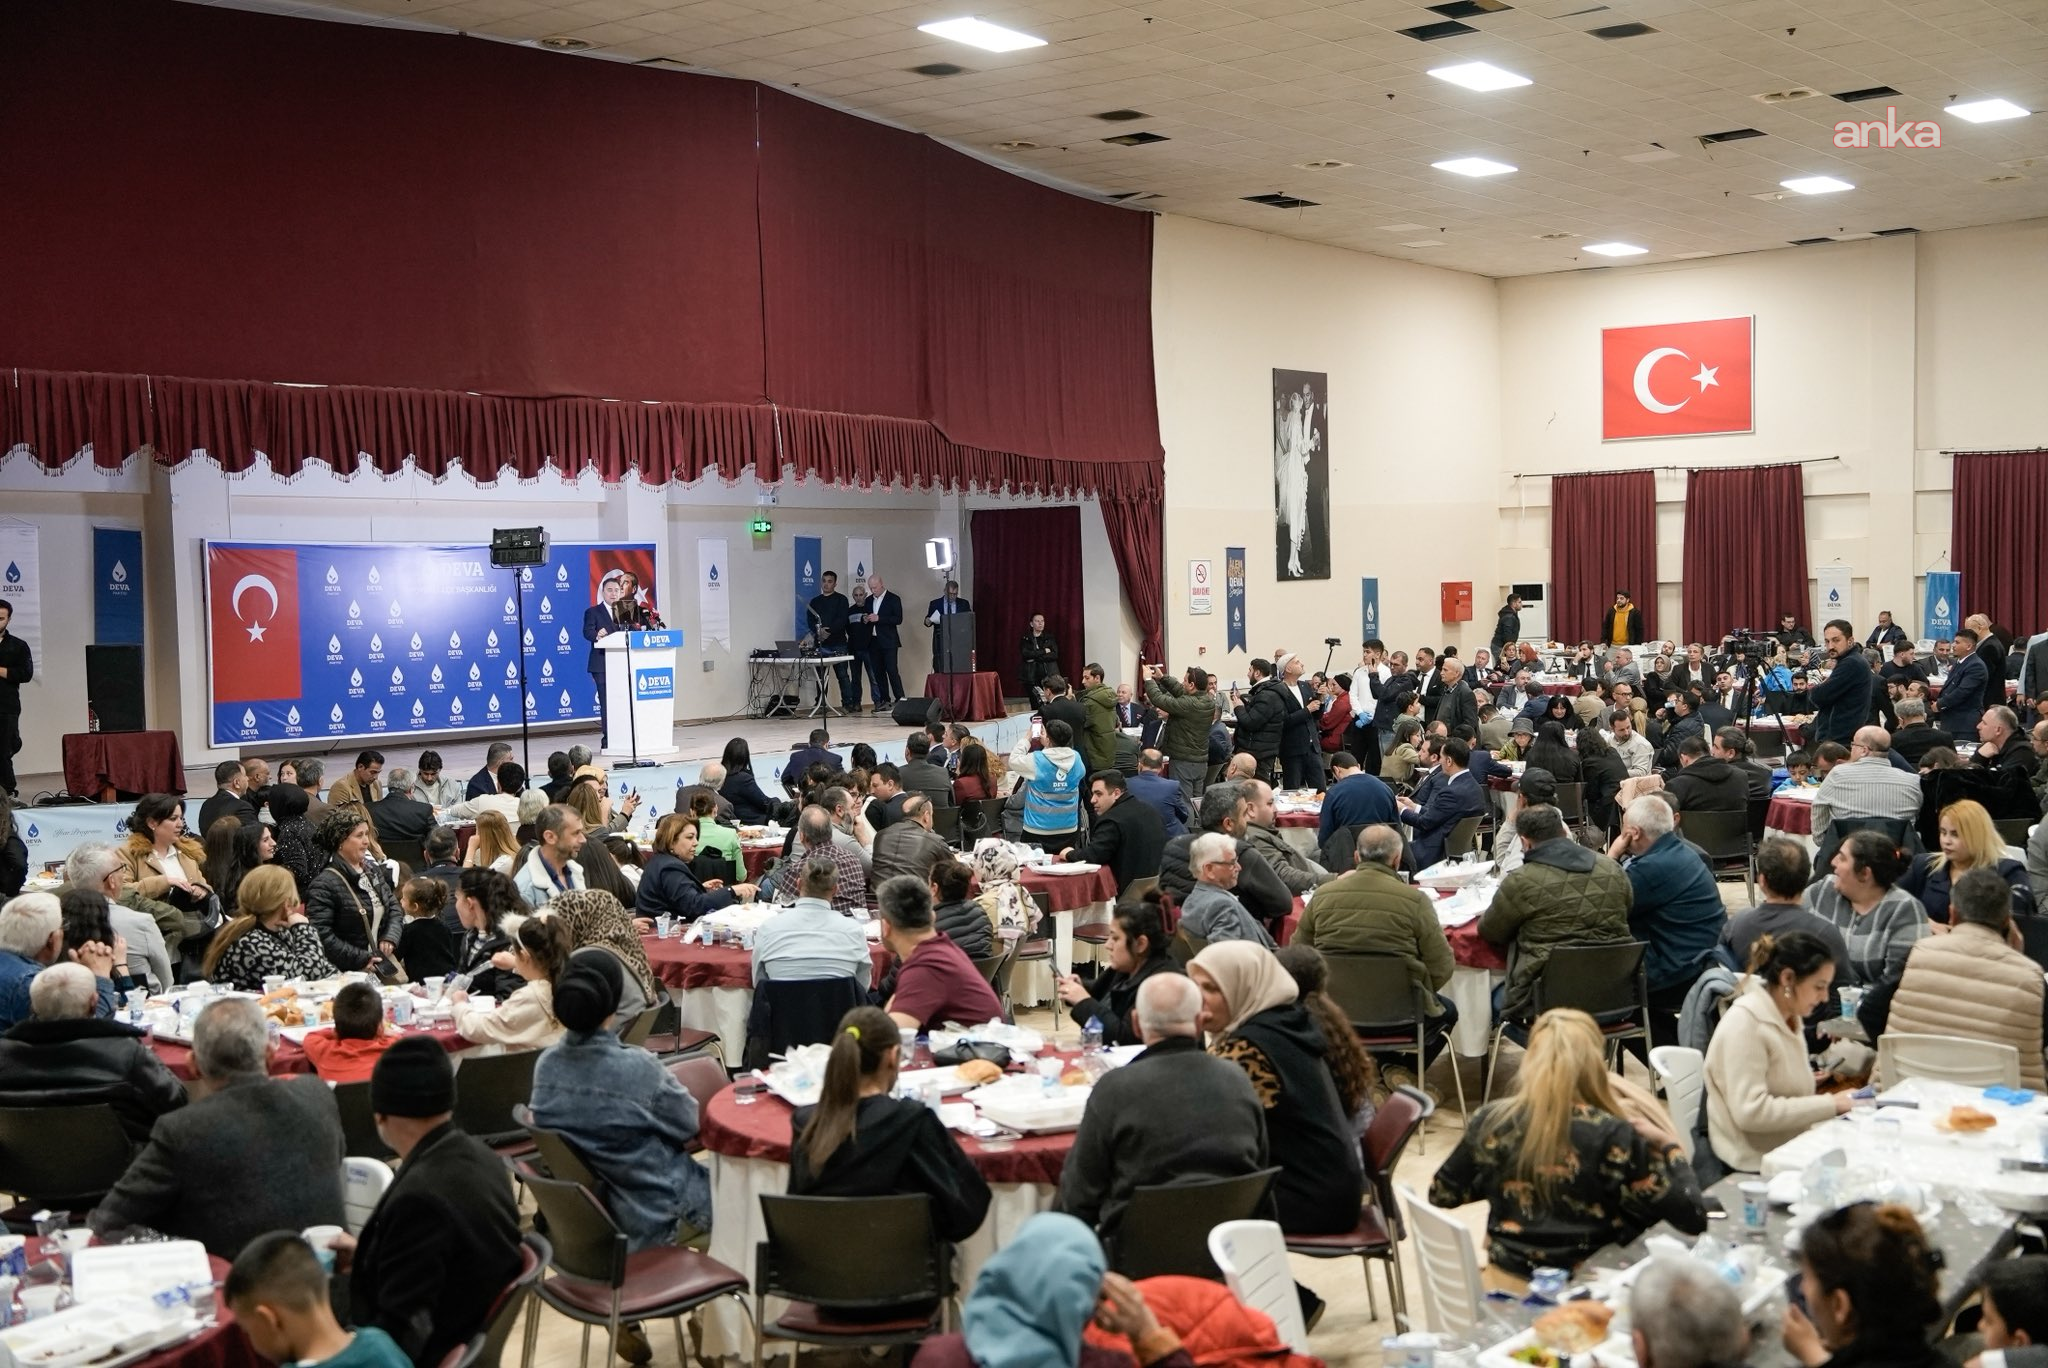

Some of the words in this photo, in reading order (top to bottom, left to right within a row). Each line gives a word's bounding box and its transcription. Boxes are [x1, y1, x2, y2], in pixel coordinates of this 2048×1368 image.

[441, 561, 484, 577] DEVA
[109, 583, 130, 591] DEVA
[1931, 618, 1952, 626] DEVA
[651, 635, 670, 644] DEVA
[648, 676, 671, 686] DEVA
